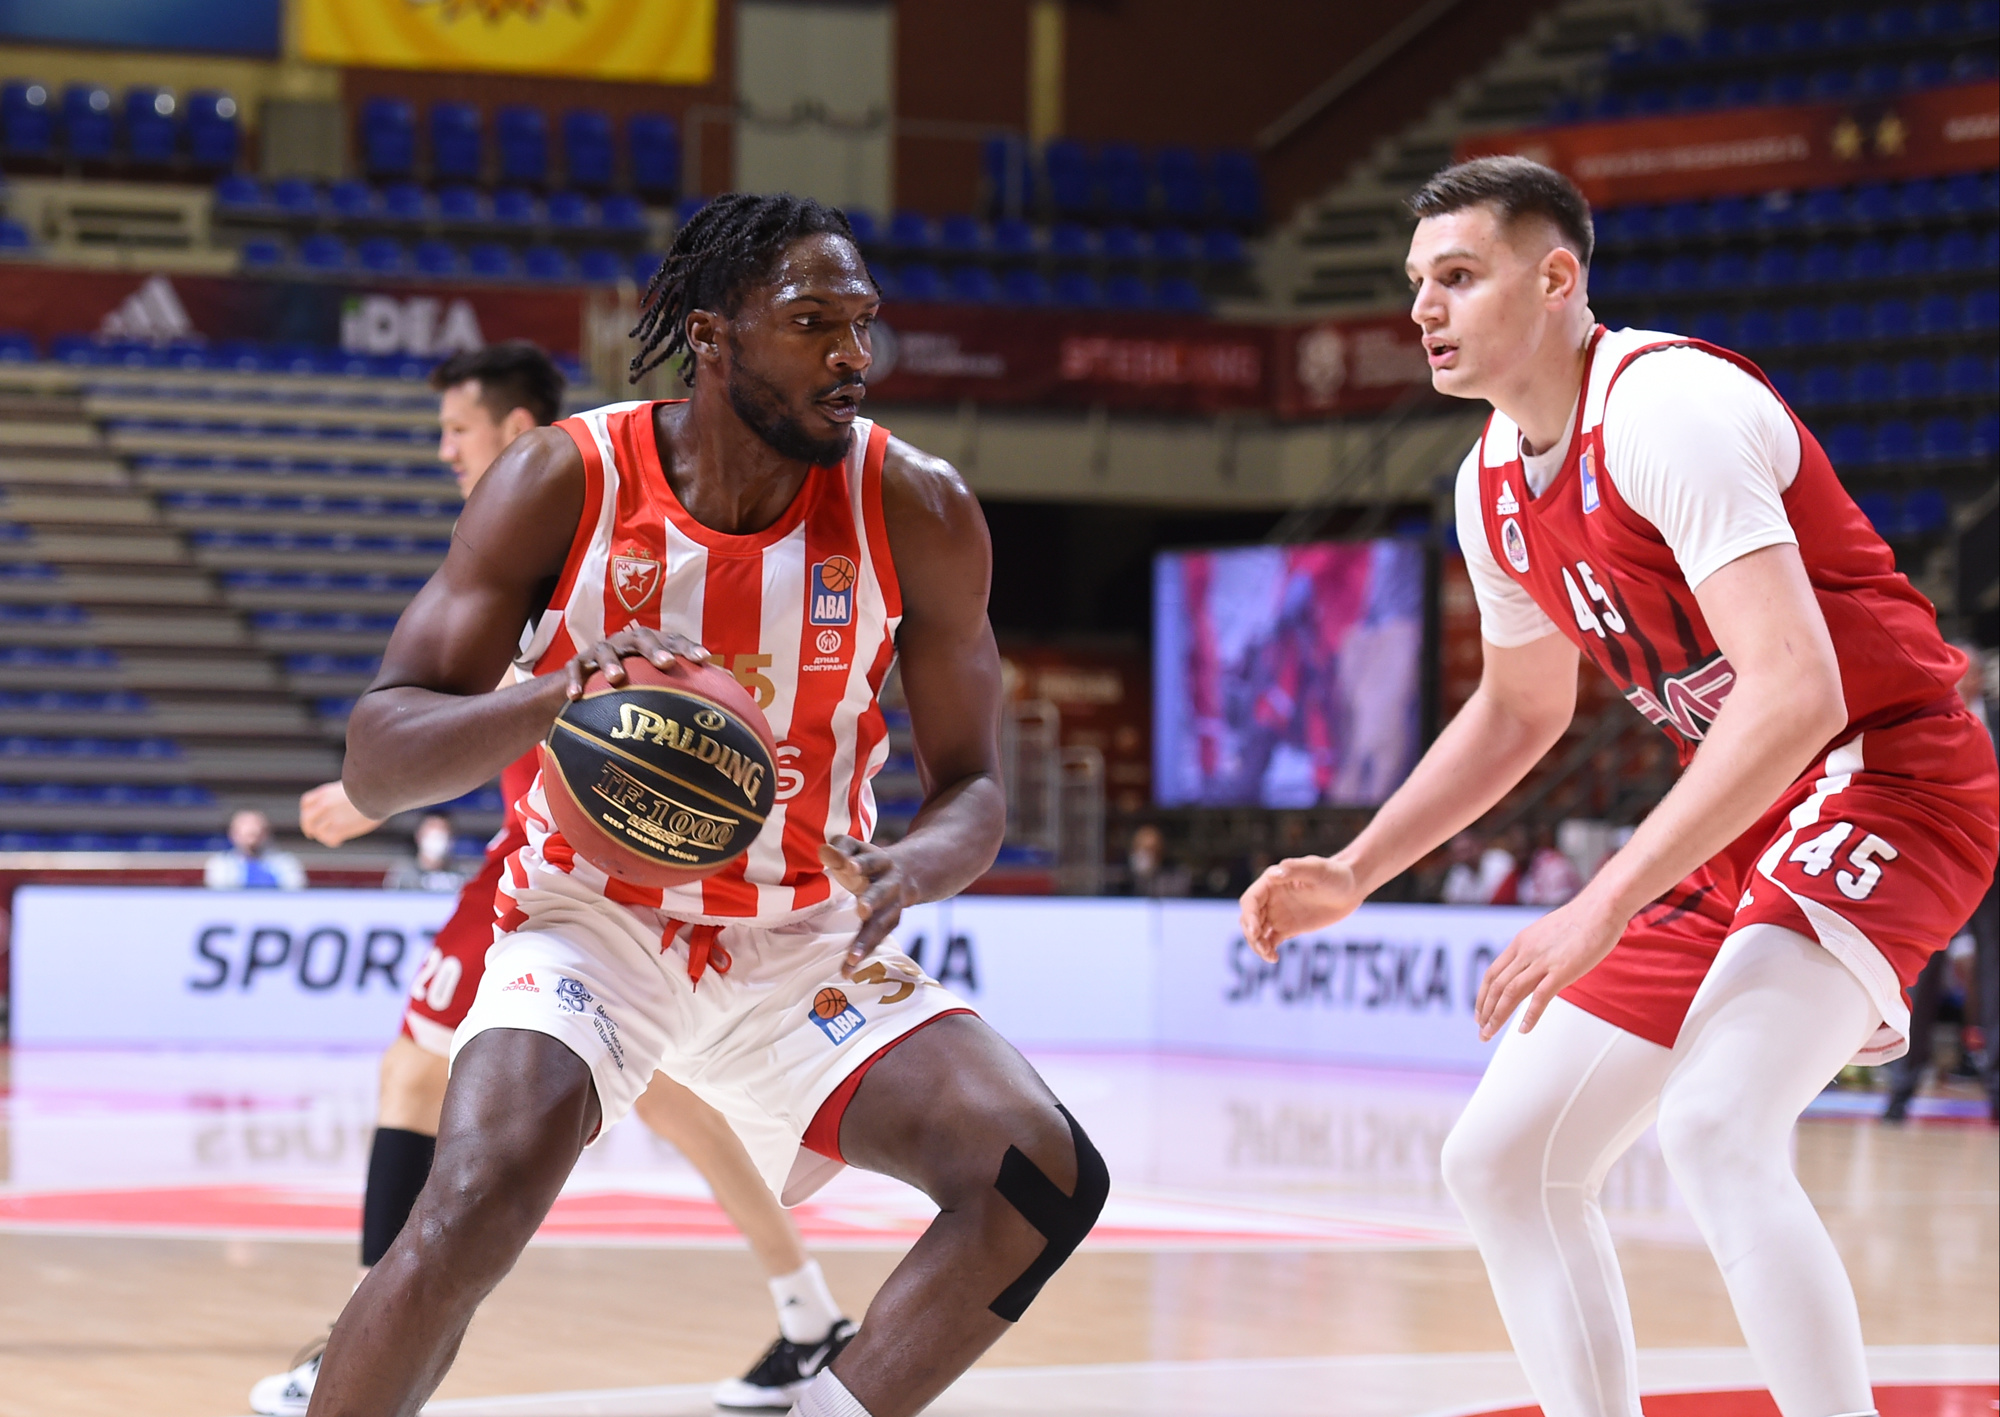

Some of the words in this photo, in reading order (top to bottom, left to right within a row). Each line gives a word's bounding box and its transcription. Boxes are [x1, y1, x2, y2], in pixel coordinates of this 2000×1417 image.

[814, 594, 847, 619] ABA
[1561, 560, 1626, 639] 45
[708, 654, 775, 710] 5
[610, 703, 766, 808] SPALDING
[597, 763, 735, 846] TF-1000
[1788, 821, 1898, 901] 45
[410, 945, 463, 1012] 20
[502, 983, 540, 993] adidas
[827, 1009, 862, 1043] ABA
